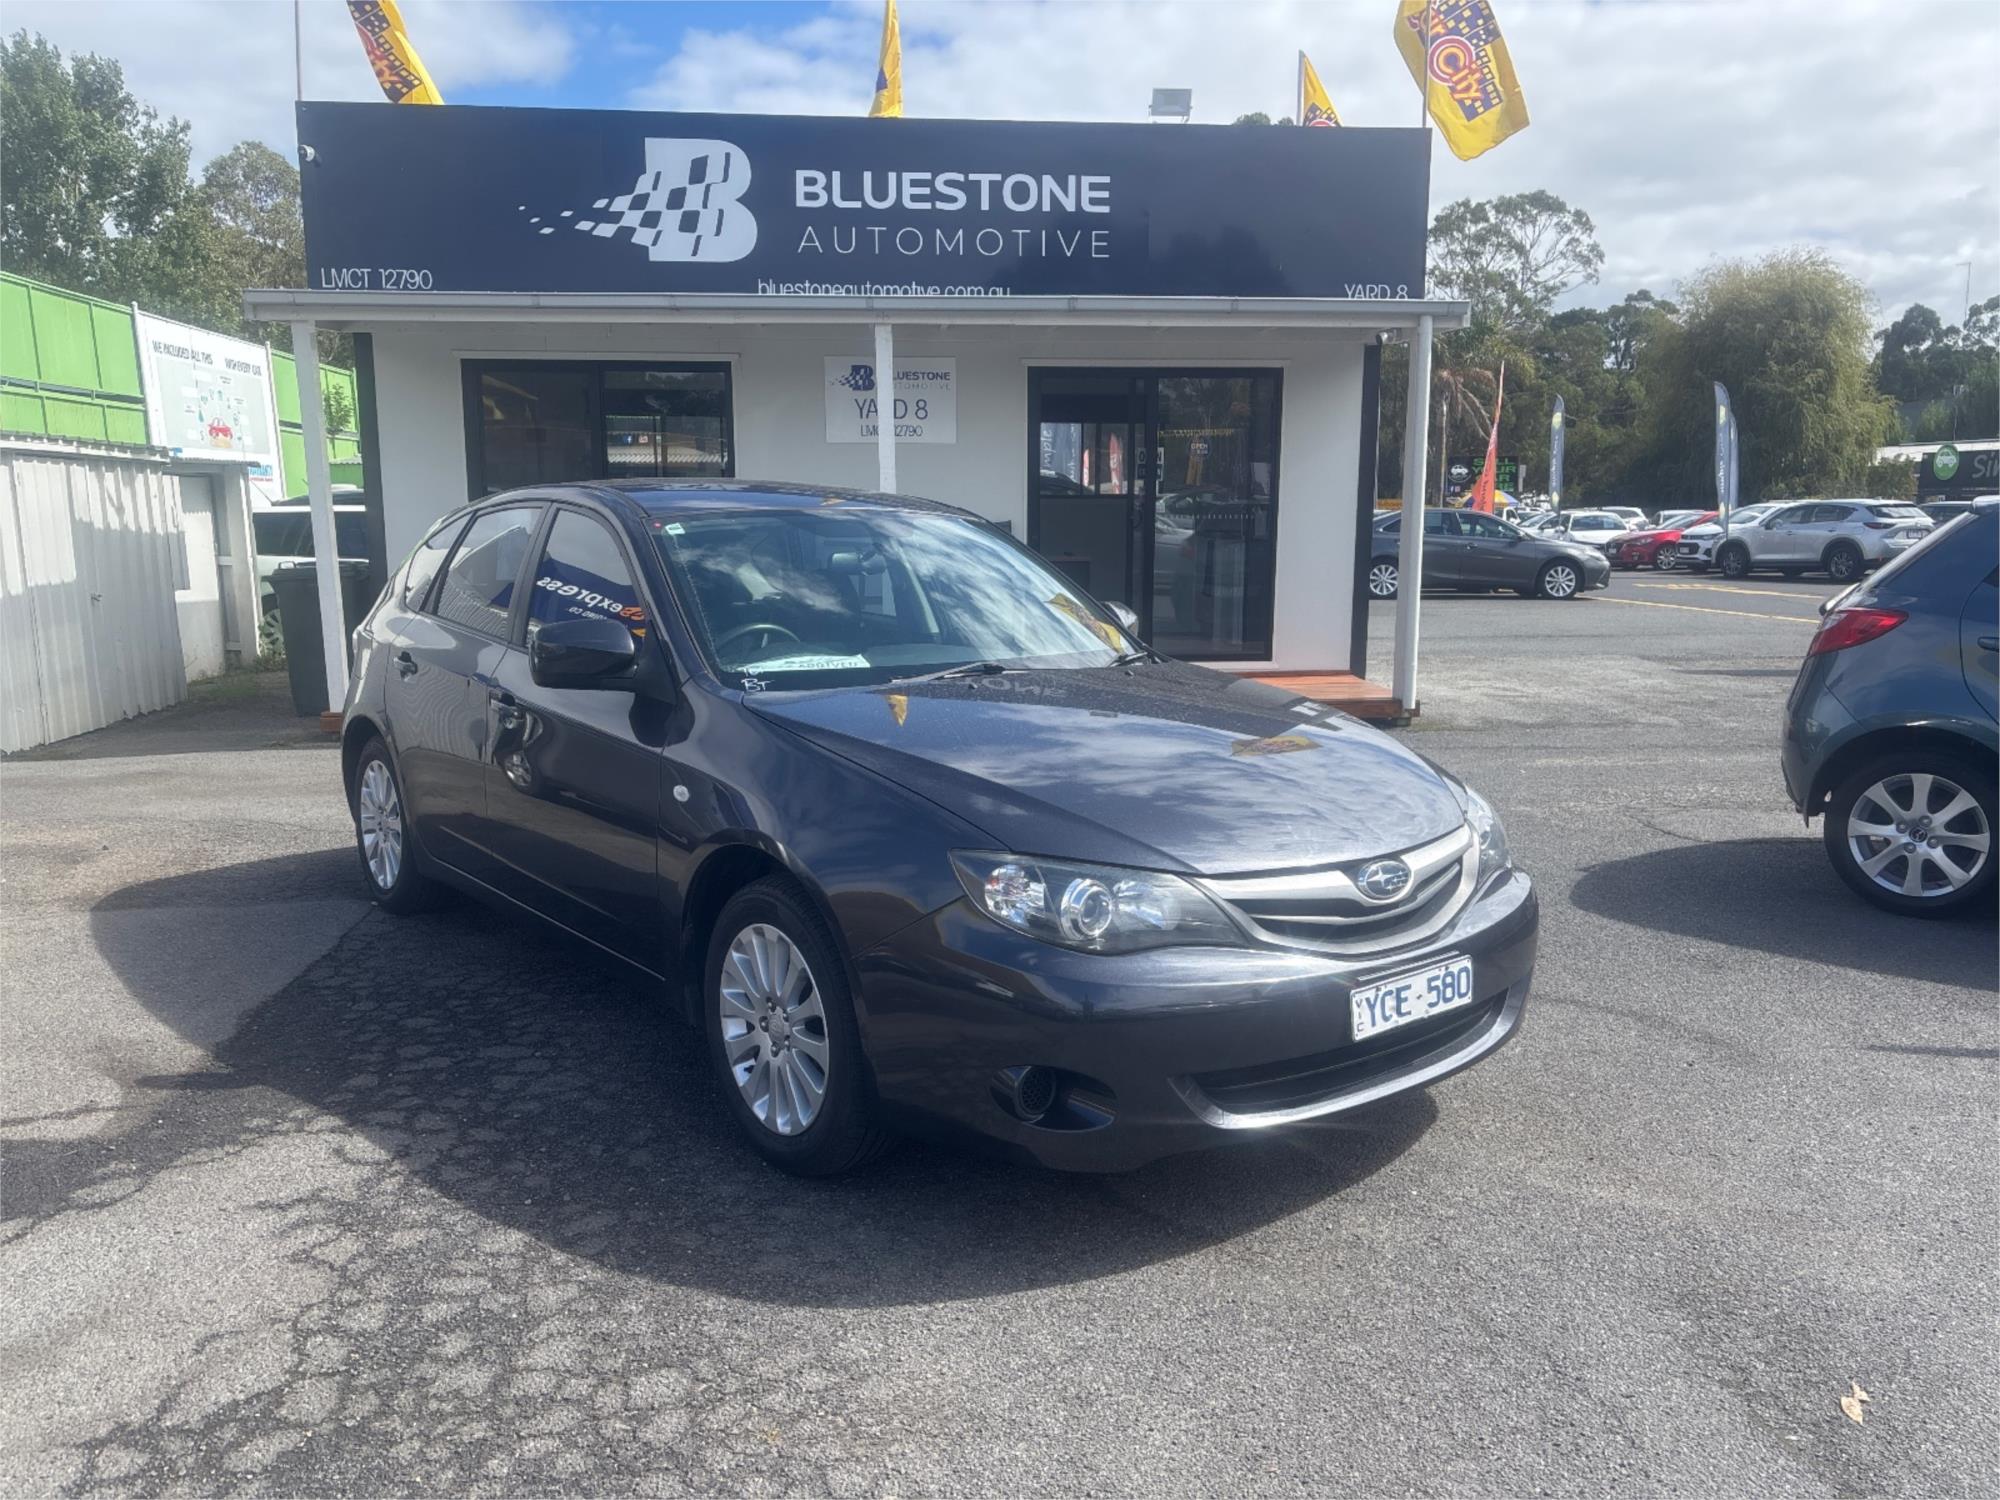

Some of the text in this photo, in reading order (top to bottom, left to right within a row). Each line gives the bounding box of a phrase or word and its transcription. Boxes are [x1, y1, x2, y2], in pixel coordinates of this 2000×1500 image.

[795, 169, 1111, 213] BLUESTONE
[797, 225, 1111, 258] AUTOMOTIVE
[321, 268, 433, 290] LMCT 12790
[757, 278, 1011, 296] bluestoneautomotive.com.au
[1344, 283, 1408, 300] YARD 8
[854, 398, 928, 420] YAD 8
[1365, 965, 1471, 1028] YCE 580
[1355, 998, 1365, 1033] VIC
